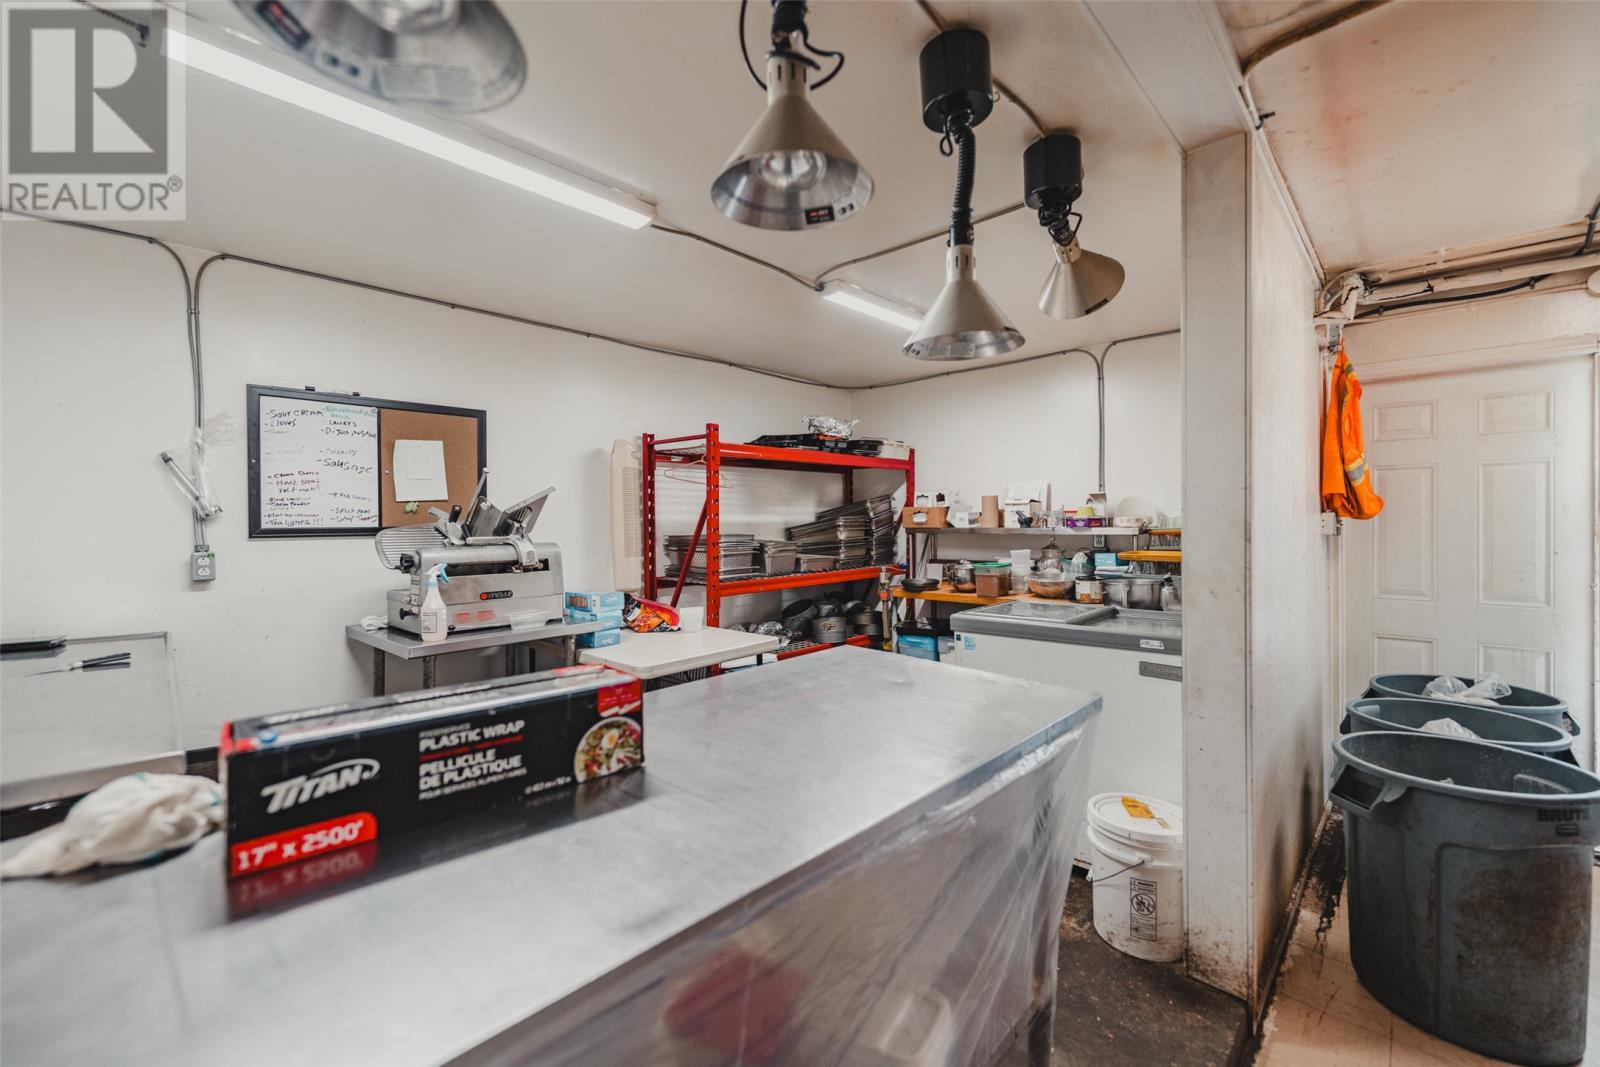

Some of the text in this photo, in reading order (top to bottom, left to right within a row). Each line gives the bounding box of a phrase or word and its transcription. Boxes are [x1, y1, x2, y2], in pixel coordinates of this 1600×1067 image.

[419, 719, 526, 752] PLASTIC WRAP
[419, 749, 496, 776] PELLICULE
[419, 775, 441, 791] DE
[443, 754, 522, 785] PLASTIQUE
[260, 764, 364, 814] TITAN
